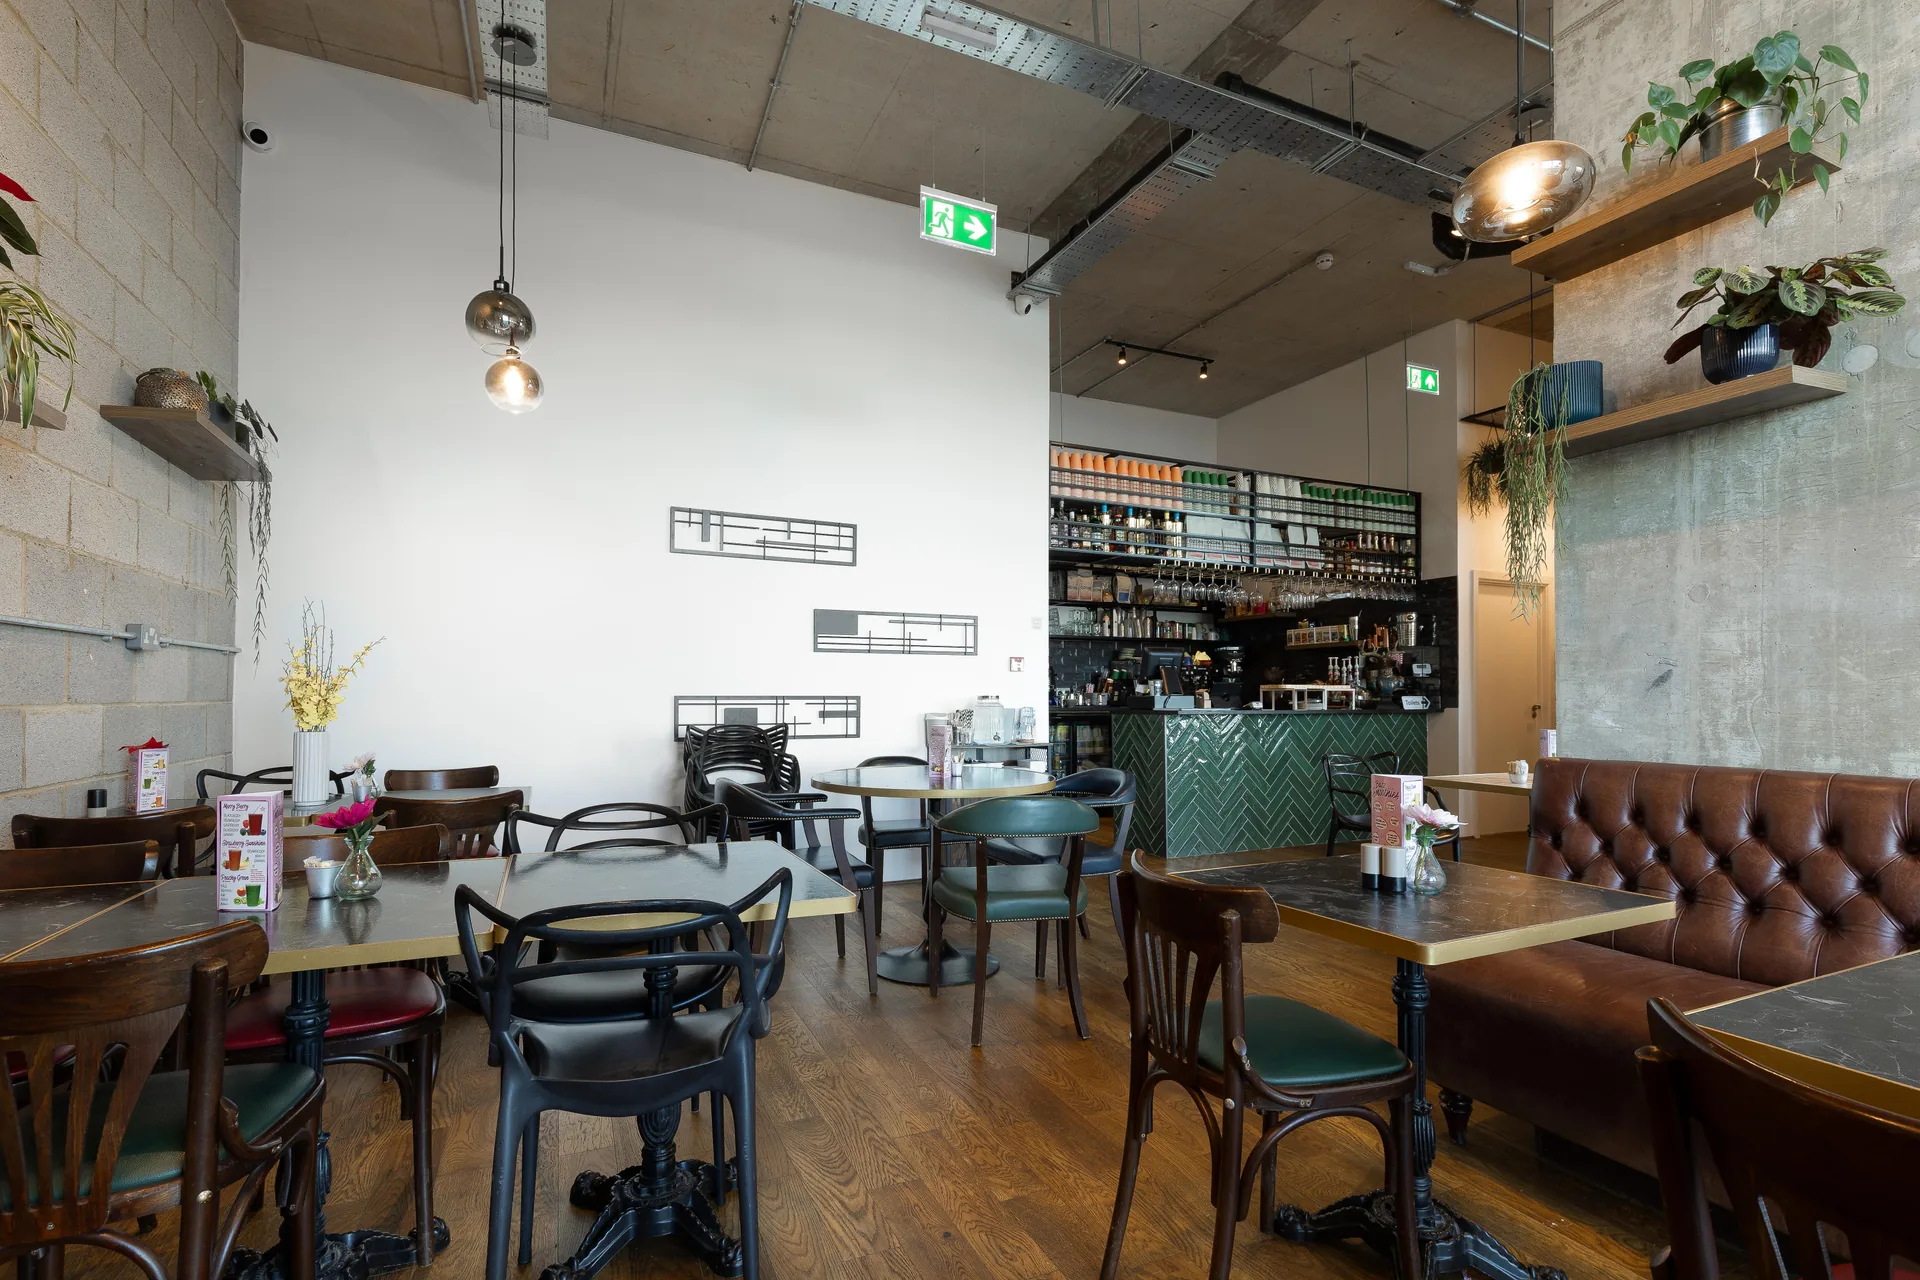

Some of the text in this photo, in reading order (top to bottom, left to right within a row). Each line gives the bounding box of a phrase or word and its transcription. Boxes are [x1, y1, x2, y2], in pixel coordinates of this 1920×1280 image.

[223, 803, 249, 811] Merry Berry
[222, 840, 245, 848] Strawberry
[221, 874, 236, 883] Peachy
[237, 874, 249, 882] Green
